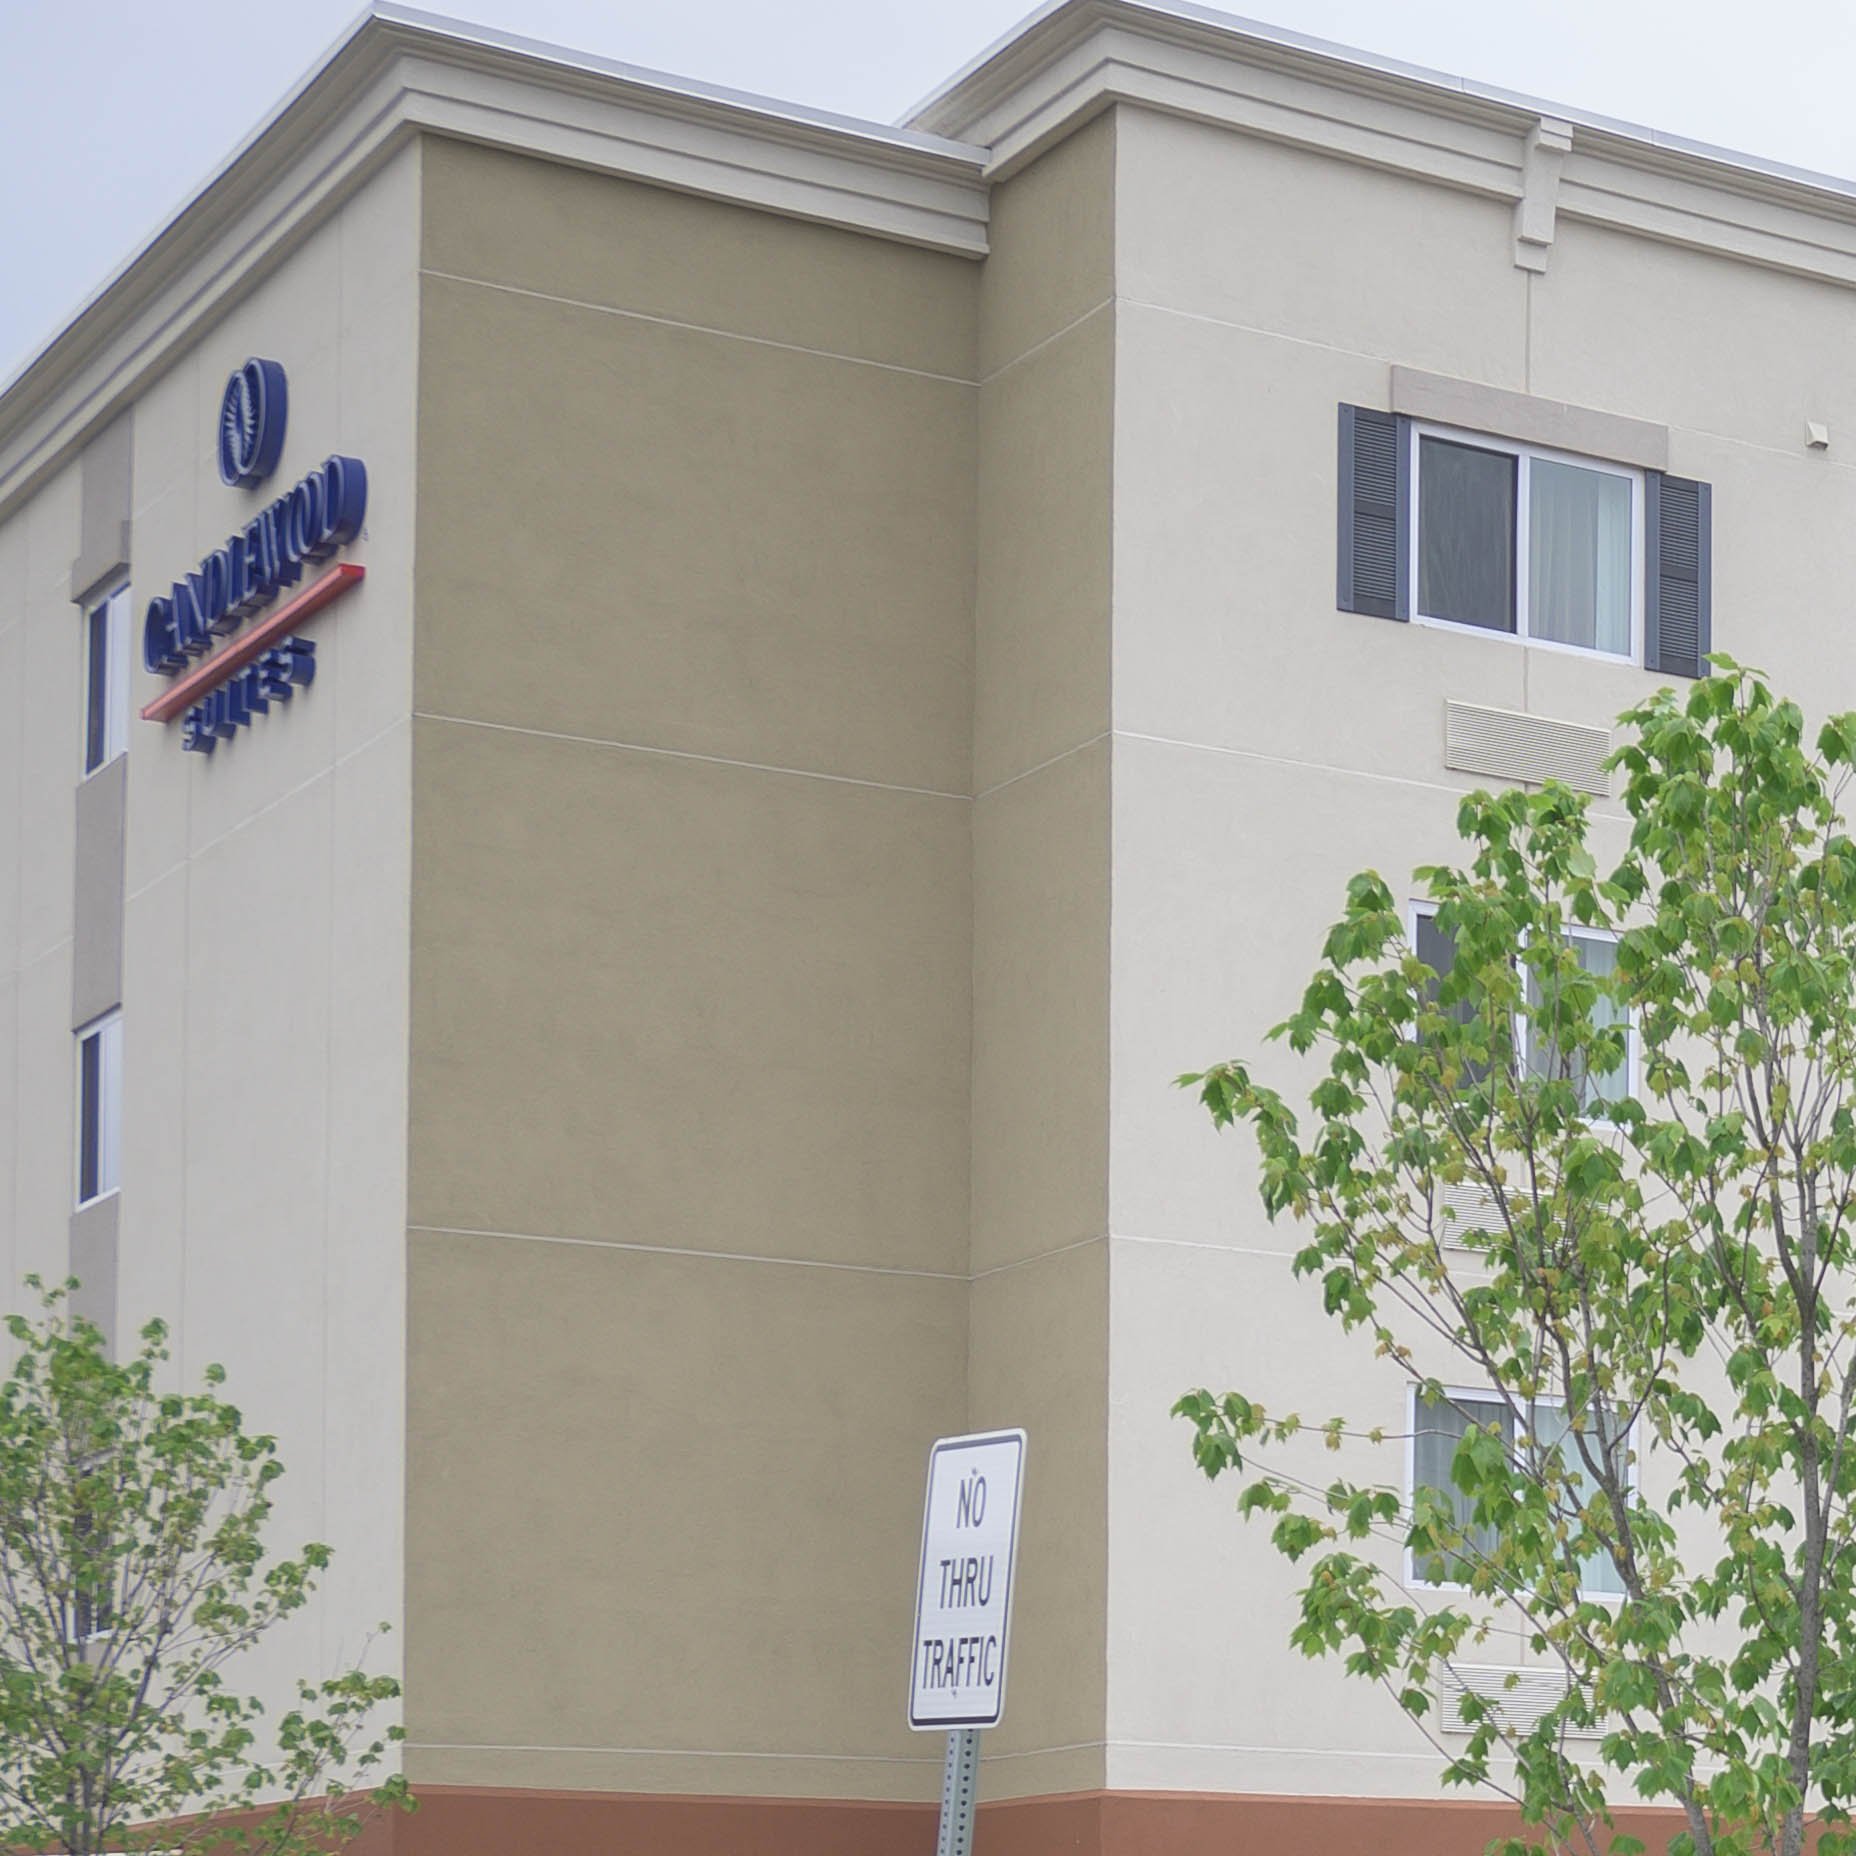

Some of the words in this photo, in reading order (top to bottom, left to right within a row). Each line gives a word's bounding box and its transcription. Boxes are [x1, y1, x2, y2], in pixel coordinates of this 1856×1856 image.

[182, 634, 317, 755] SUITES
[956, 1475, 987, 1529] NO
[939, 1555, 994, 1609] THRU
[922, 1635, 997, 1690] TRAFFIC
